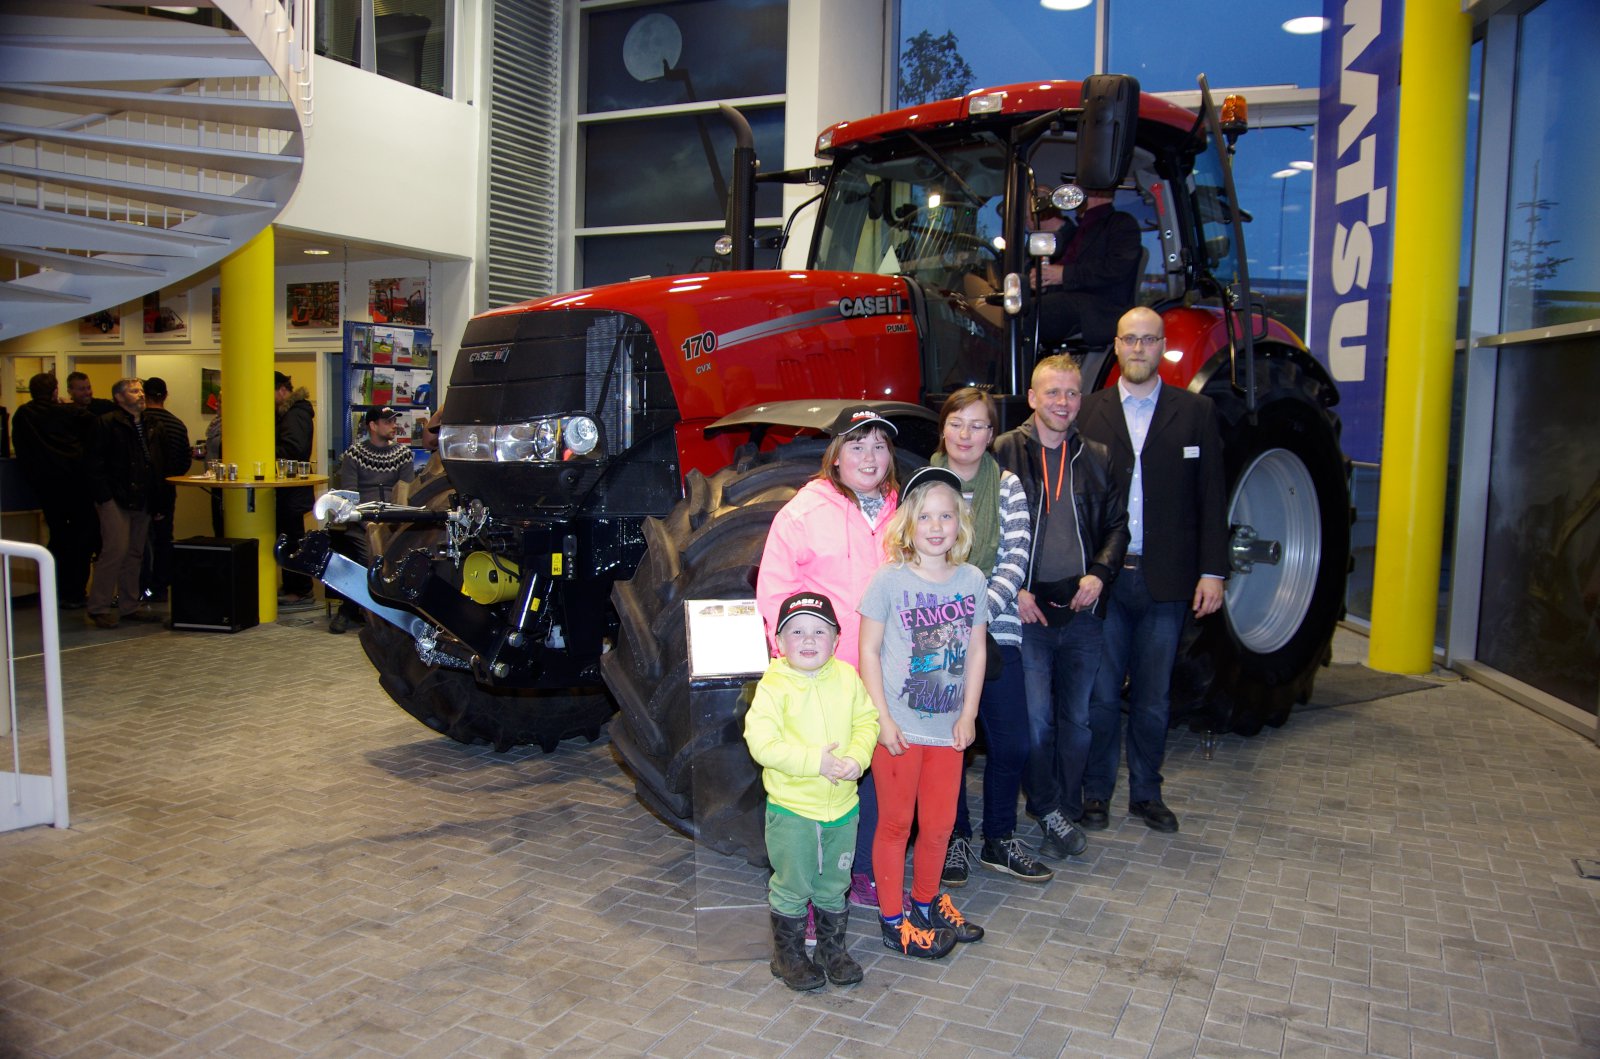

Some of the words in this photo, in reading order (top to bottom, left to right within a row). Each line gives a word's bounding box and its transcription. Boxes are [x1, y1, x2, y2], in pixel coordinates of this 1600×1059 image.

[885, 323, 911, 335] PUMA
[681, 330, 717, 361] 170
[468, 350, 494, 363] CASE
[695, 362, 712, 376] CVX
[903, 590, 909, 608] I
[915, 591, 939, 609] AM
[900, 594, 976, 631] FAMOUS
